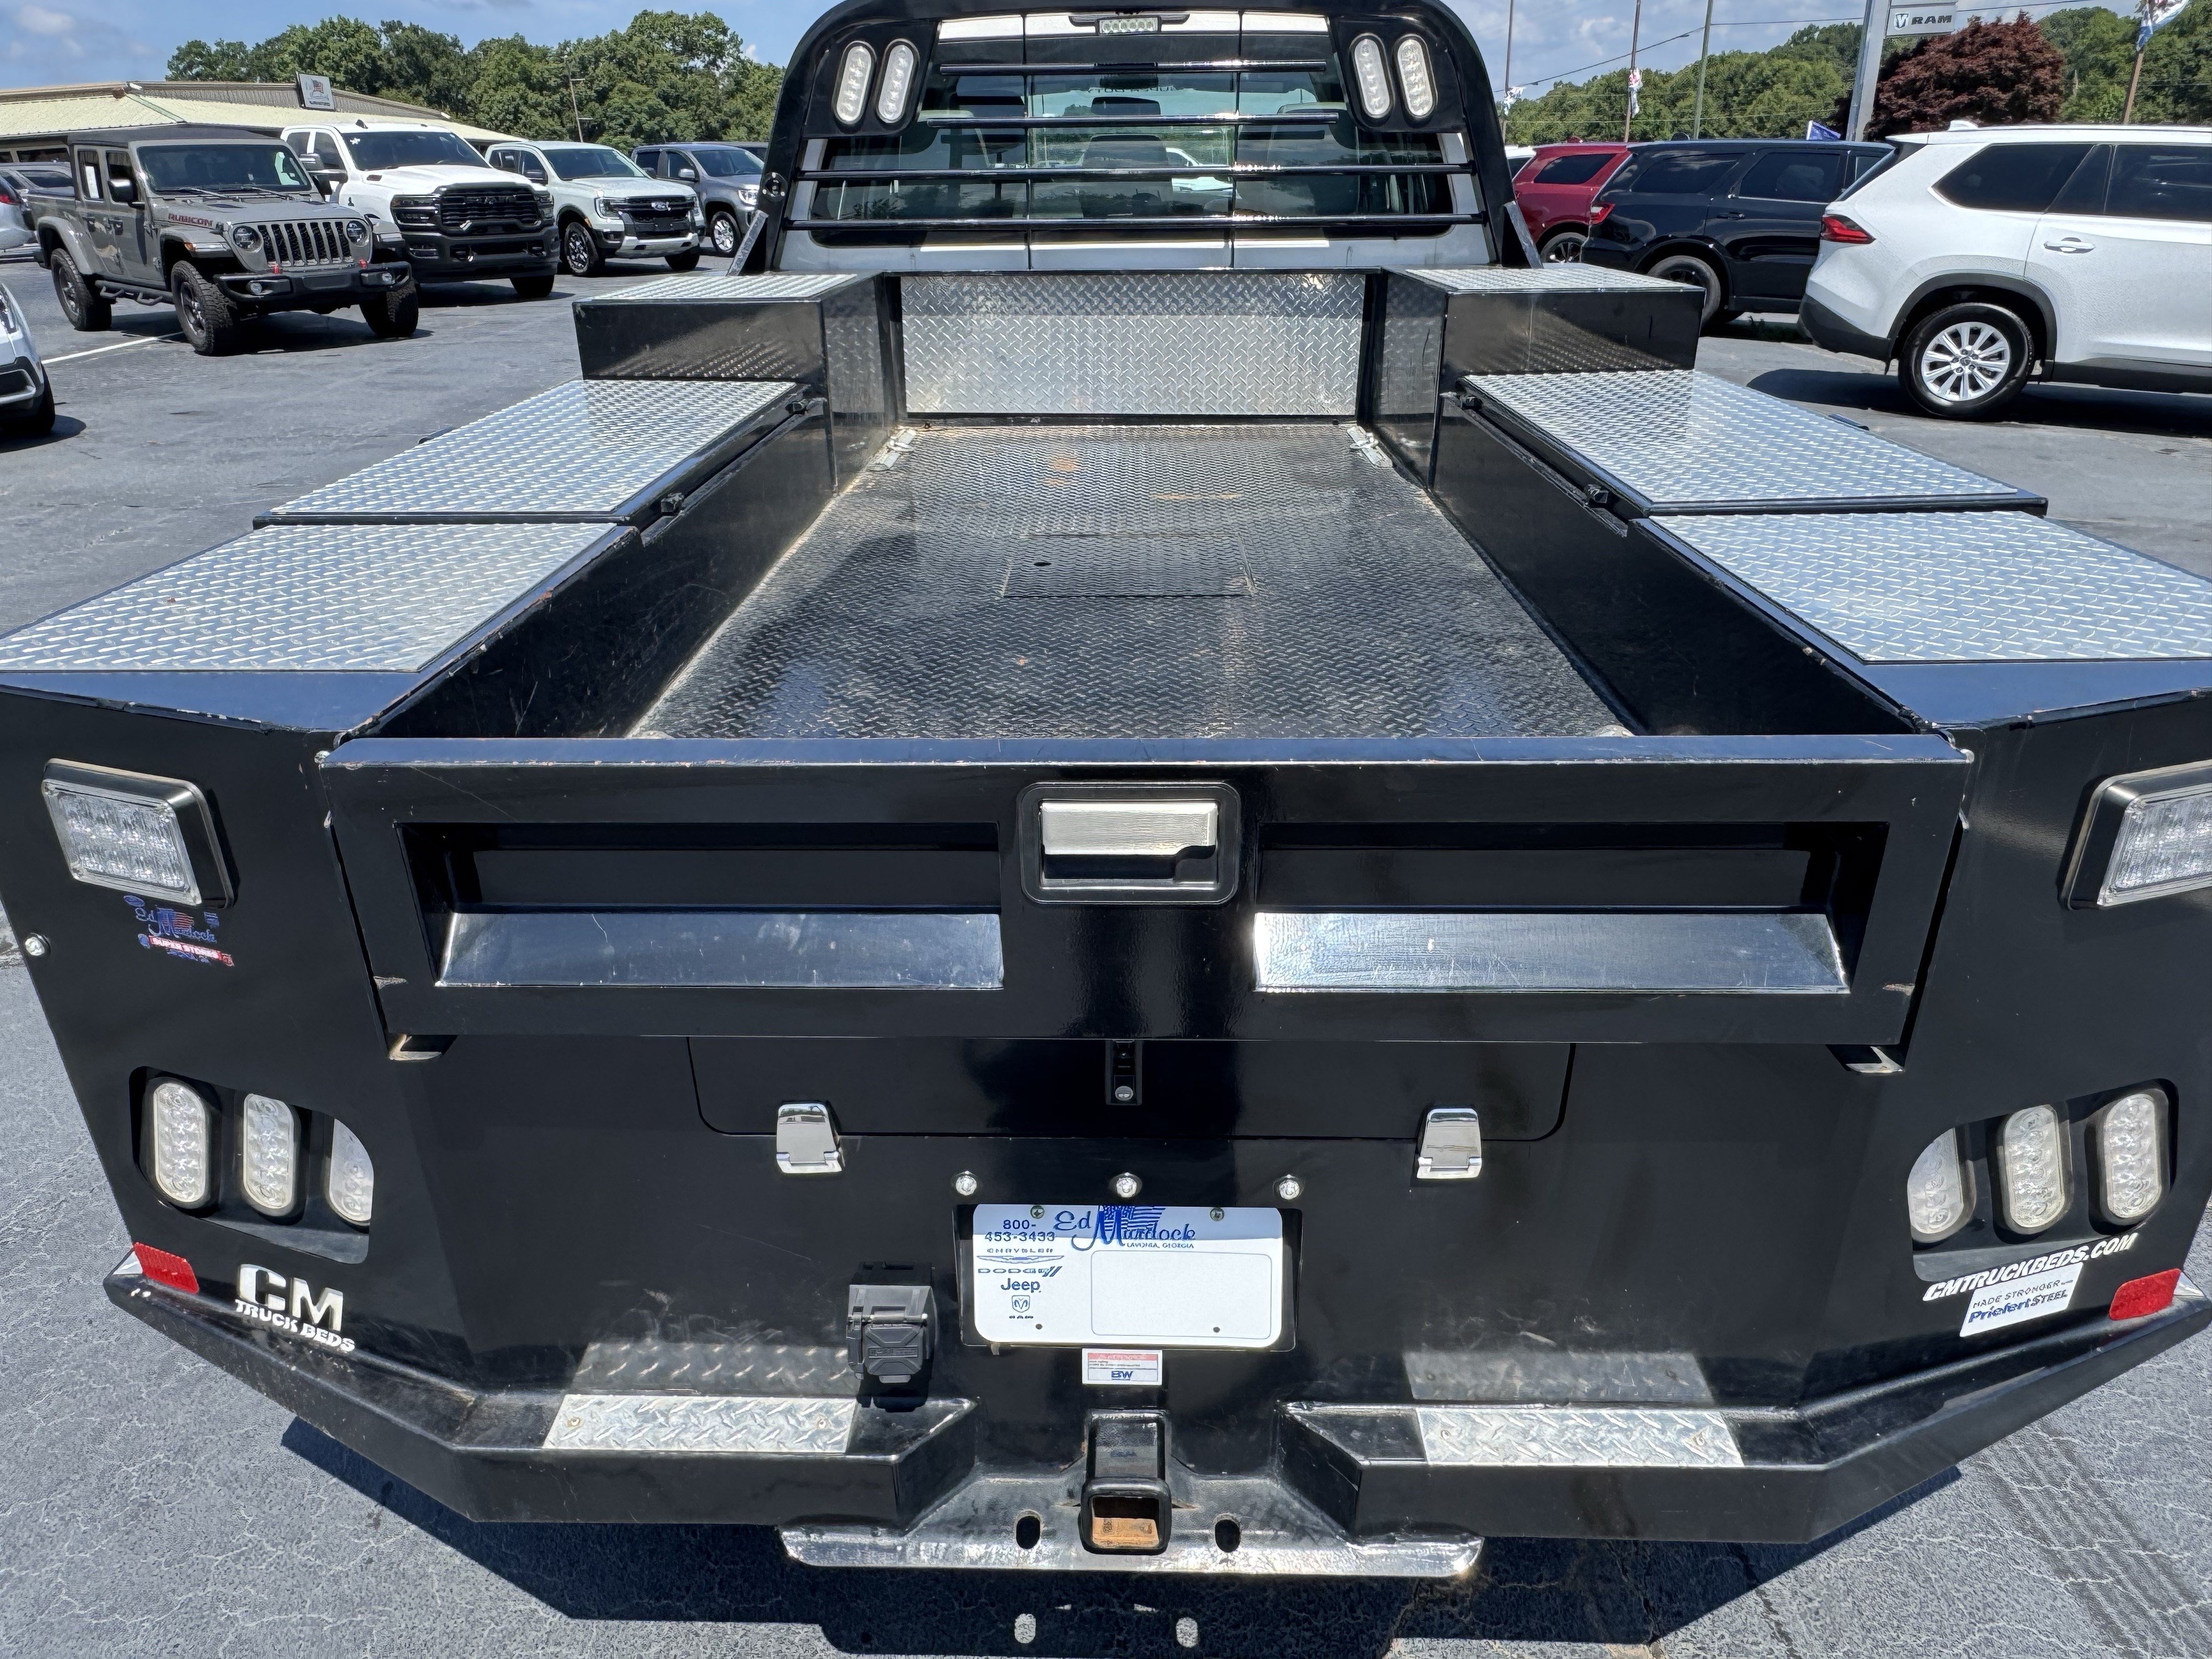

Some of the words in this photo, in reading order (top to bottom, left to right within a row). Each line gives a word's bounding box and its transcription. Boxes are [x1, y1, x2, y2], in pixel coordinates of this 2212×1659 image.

[1911, 15, 1953, 25] RAM
[168, 212, 213, 227] RUBICON
[1002, 1219, 1037, 1230] 800-
[1053, 1210, 1092, 1231] Ed
[1071, 1205, 1197, 1251] Murdock
[1922, 1232, 2140, 1302] CMTRUCKBEDS.COM
[239, 1263, 344, 1332] CM
[1000, 1278, 1041, 1293] Jeep
[1972, 1295, 2003, 1310] MADE
[2004, 1279, 2061, 1301] STRONGER
[234, 1298, 298, 1333] TRUCK
[300, 1323, 356, 1352] BEDS
